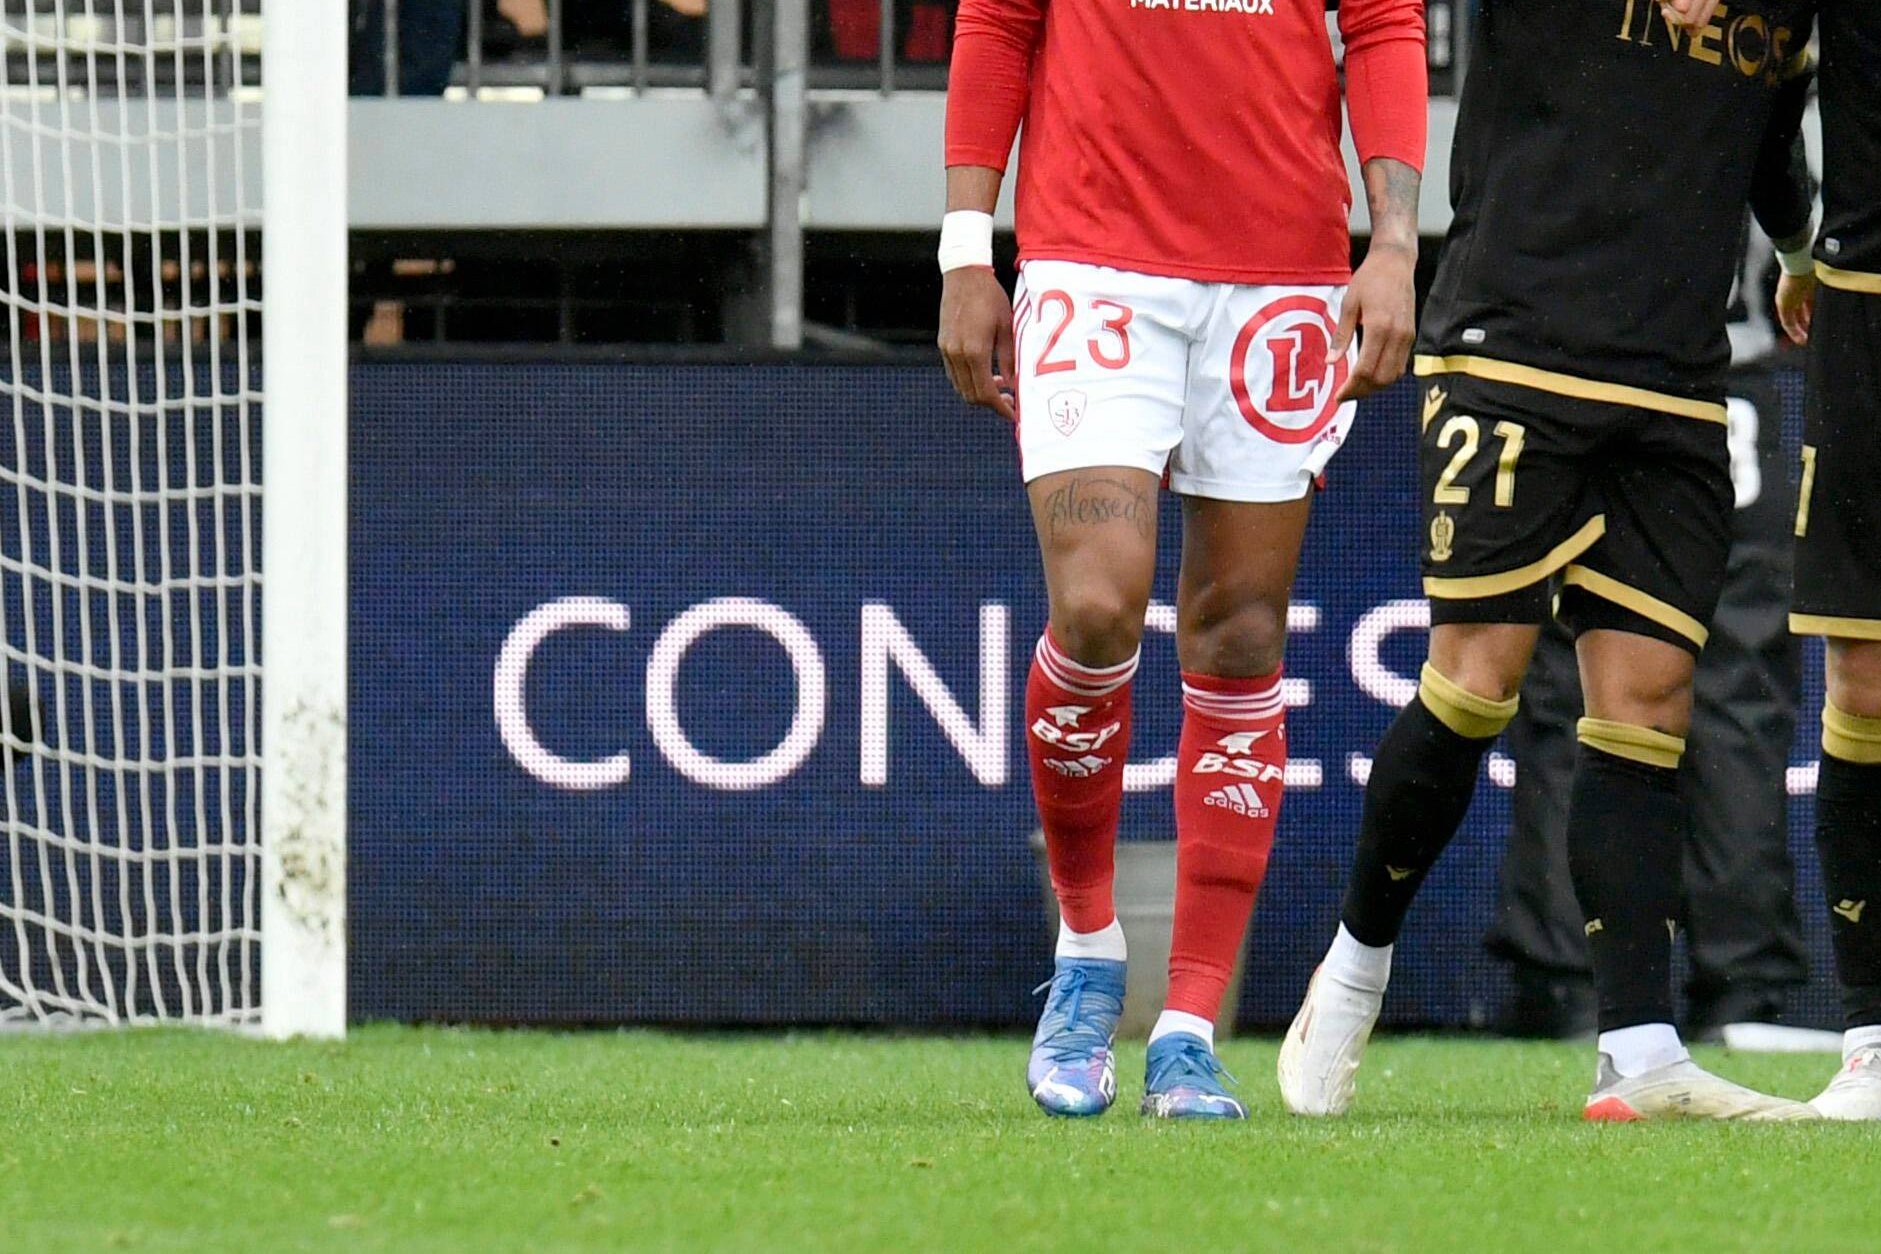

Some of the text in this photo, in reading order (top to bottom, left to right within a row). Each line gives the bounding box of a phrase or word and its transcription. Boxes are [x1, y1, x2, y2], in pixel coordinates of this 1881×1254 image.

[1034, 289, 1133, 377] 23
[1433, 414, 1525, 507] 21
[1031, 718, 1121, 752] BSP
[1192, 752, 1284, 783] BSP
[1203, 795, 1269, 819] adidas
